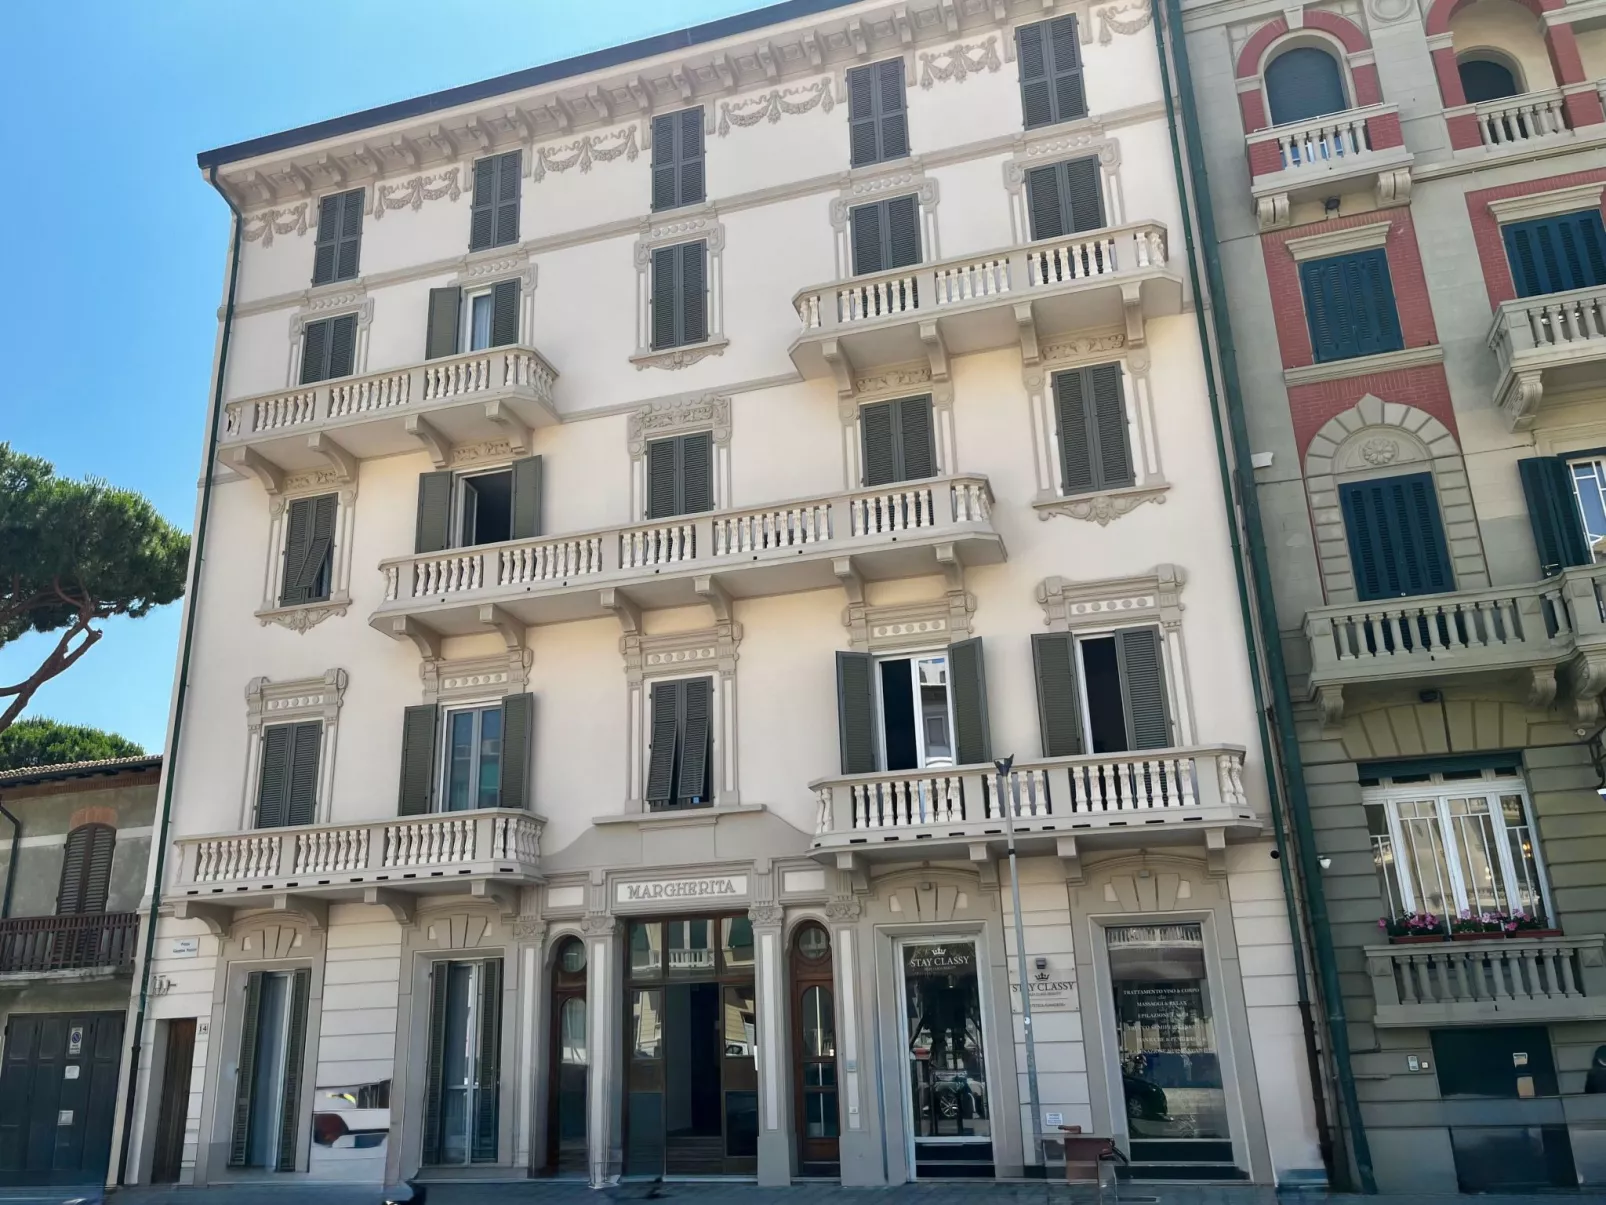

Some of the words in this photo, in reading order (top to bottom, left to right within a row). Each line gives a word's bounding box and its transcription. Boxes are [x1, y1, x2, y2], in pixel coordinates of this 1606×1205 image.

[627, 880, 736, 899] MARGHERITA
[910, 957, 933, 967] STAY
[934, 955, 970, 966] CLASSY
[1012, 983, 1036, 992] STY
[1037, 981, 1074, 991] CLASSY
